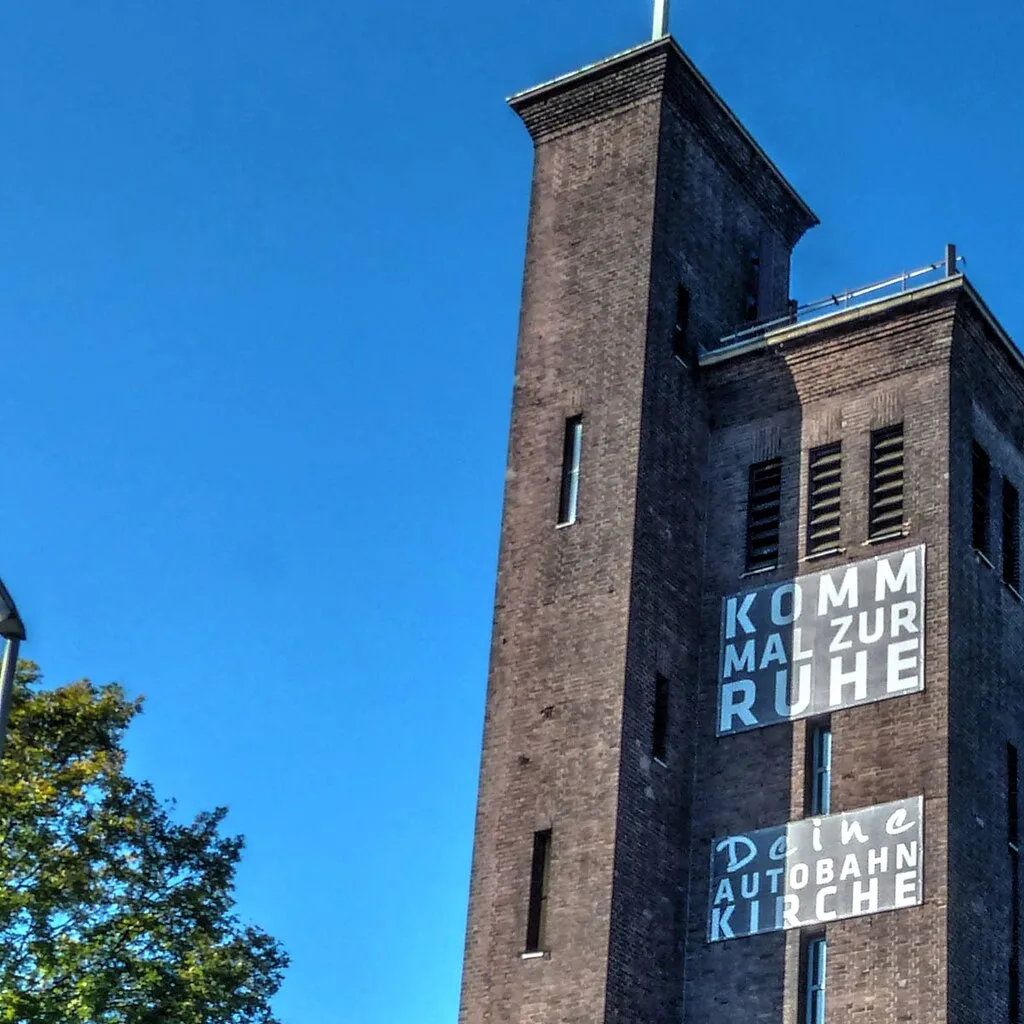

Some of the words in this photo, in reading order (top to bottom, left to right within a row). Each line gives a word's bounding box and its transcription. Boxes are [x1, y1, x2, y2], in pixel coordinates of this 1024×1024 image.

[725, 551, 917, 640] KOMM
[723, 627, 813, 678] MAL
[829, 600, 919, 653] ZUR
[720, 637, 919, 732] RUHE
[713, 841, 917, 905] AUTOBAHN
[716, 807, 916, 873] Deine
[710, 870, 917, 939] KIRCHE
